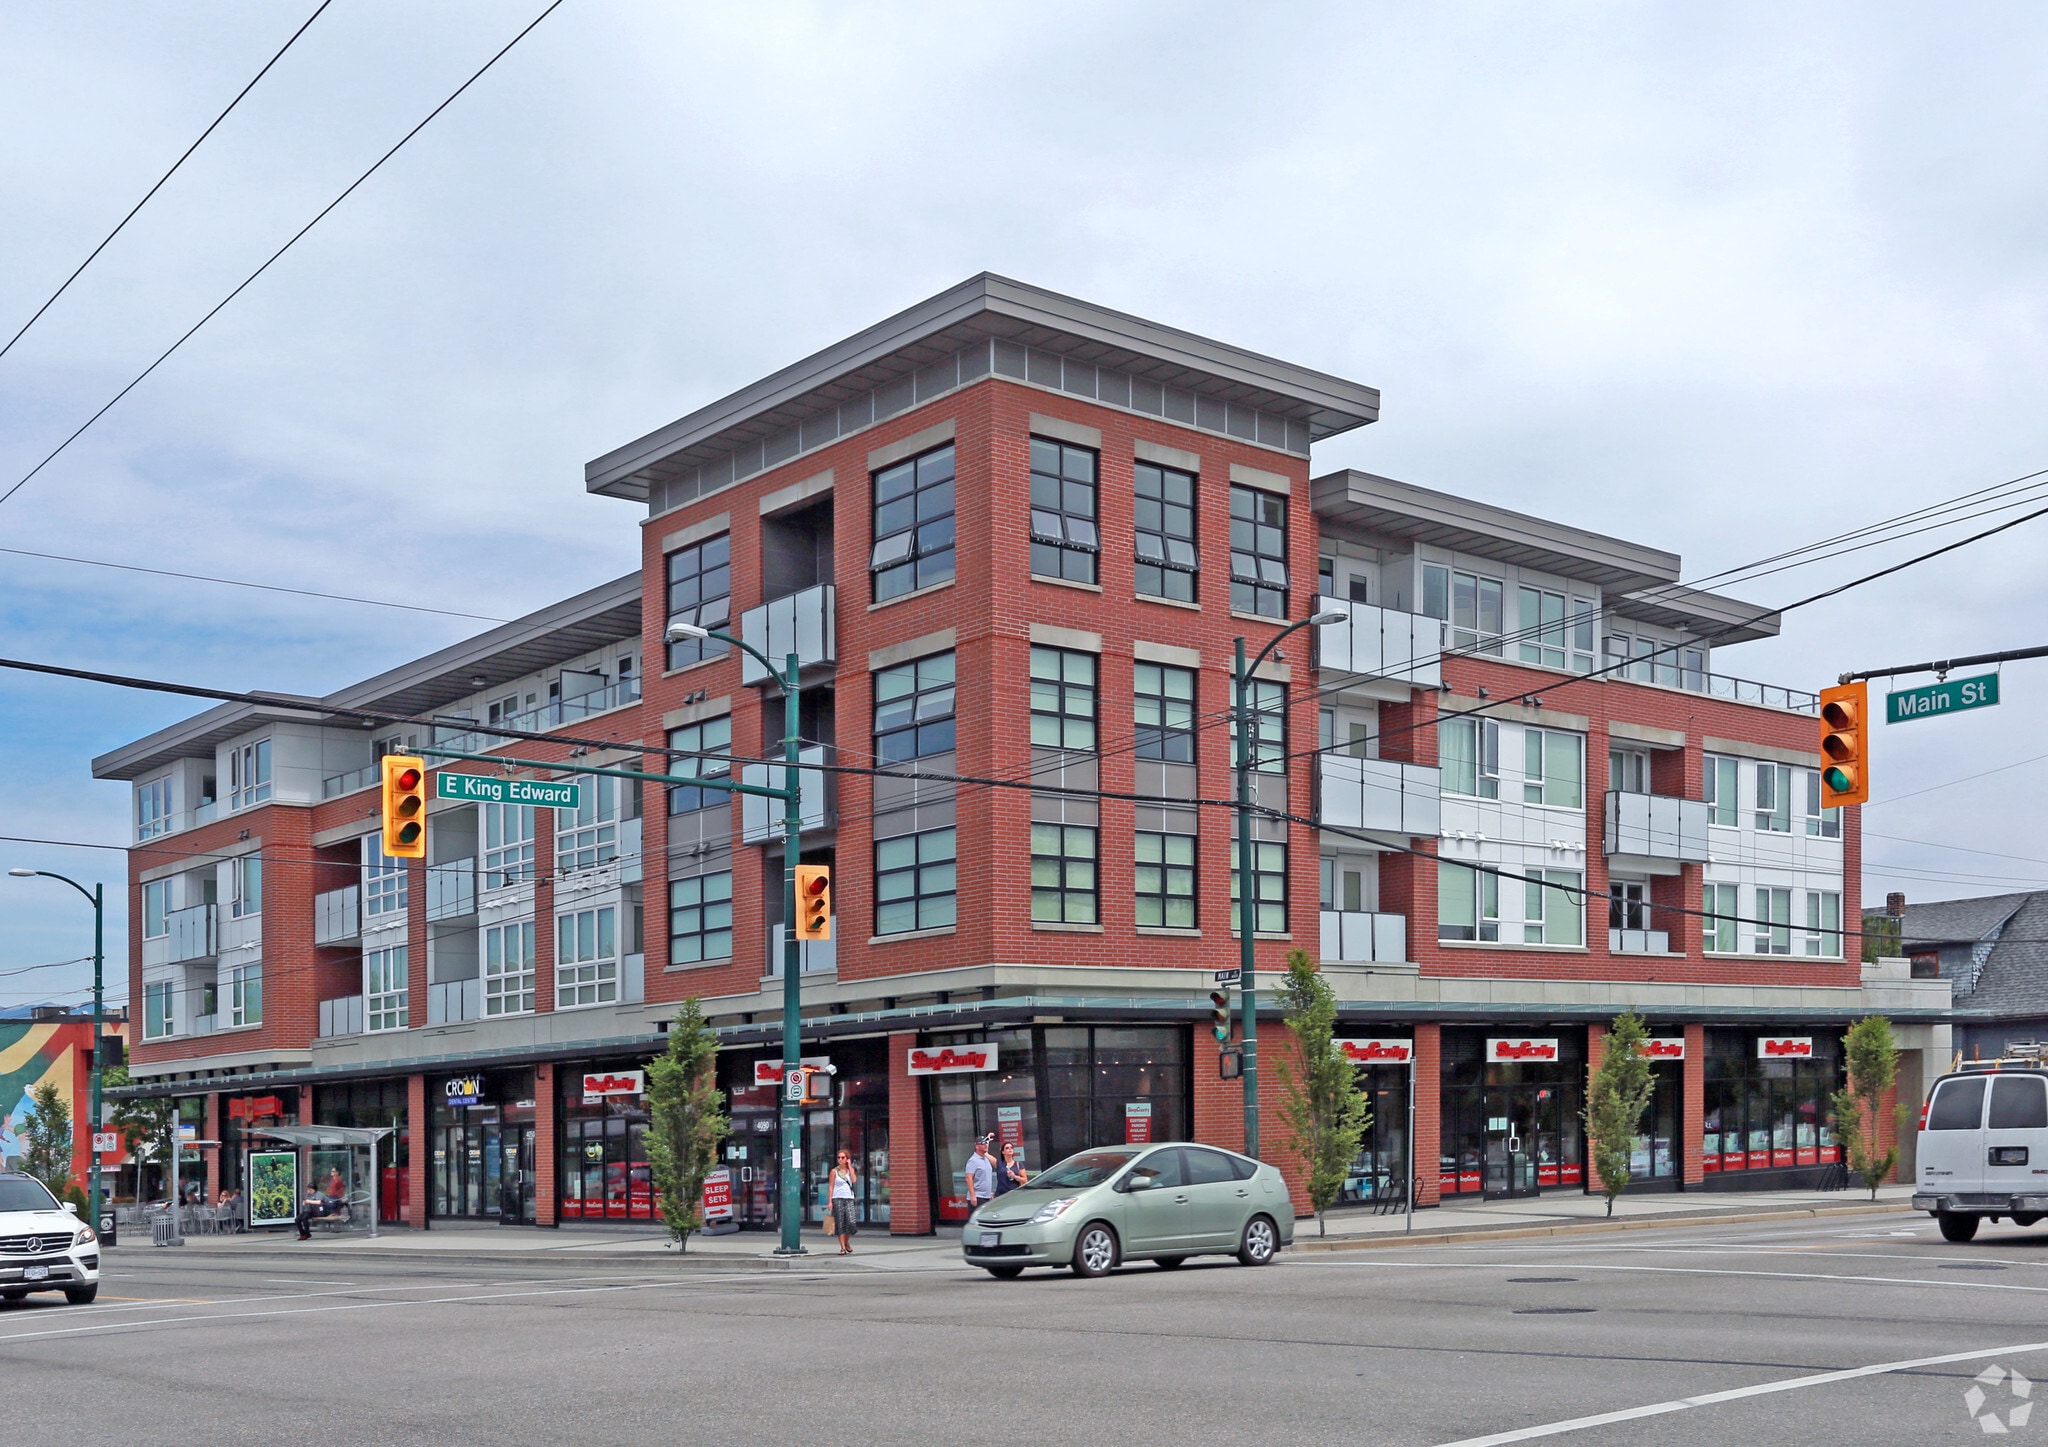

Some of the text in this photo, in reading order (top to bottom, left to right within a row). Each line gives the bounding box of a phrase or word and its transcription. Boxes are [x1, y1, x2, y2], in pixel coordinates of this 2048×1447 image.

[1898, 682, 1986, 716] Main St
[446, 776, 571, 802] E King Edward
[446, 1079, 480, 1096] CROWN
[705, 1185, 728, 1194] SLEEP
[708, 1195, 727, 1204] SETS
